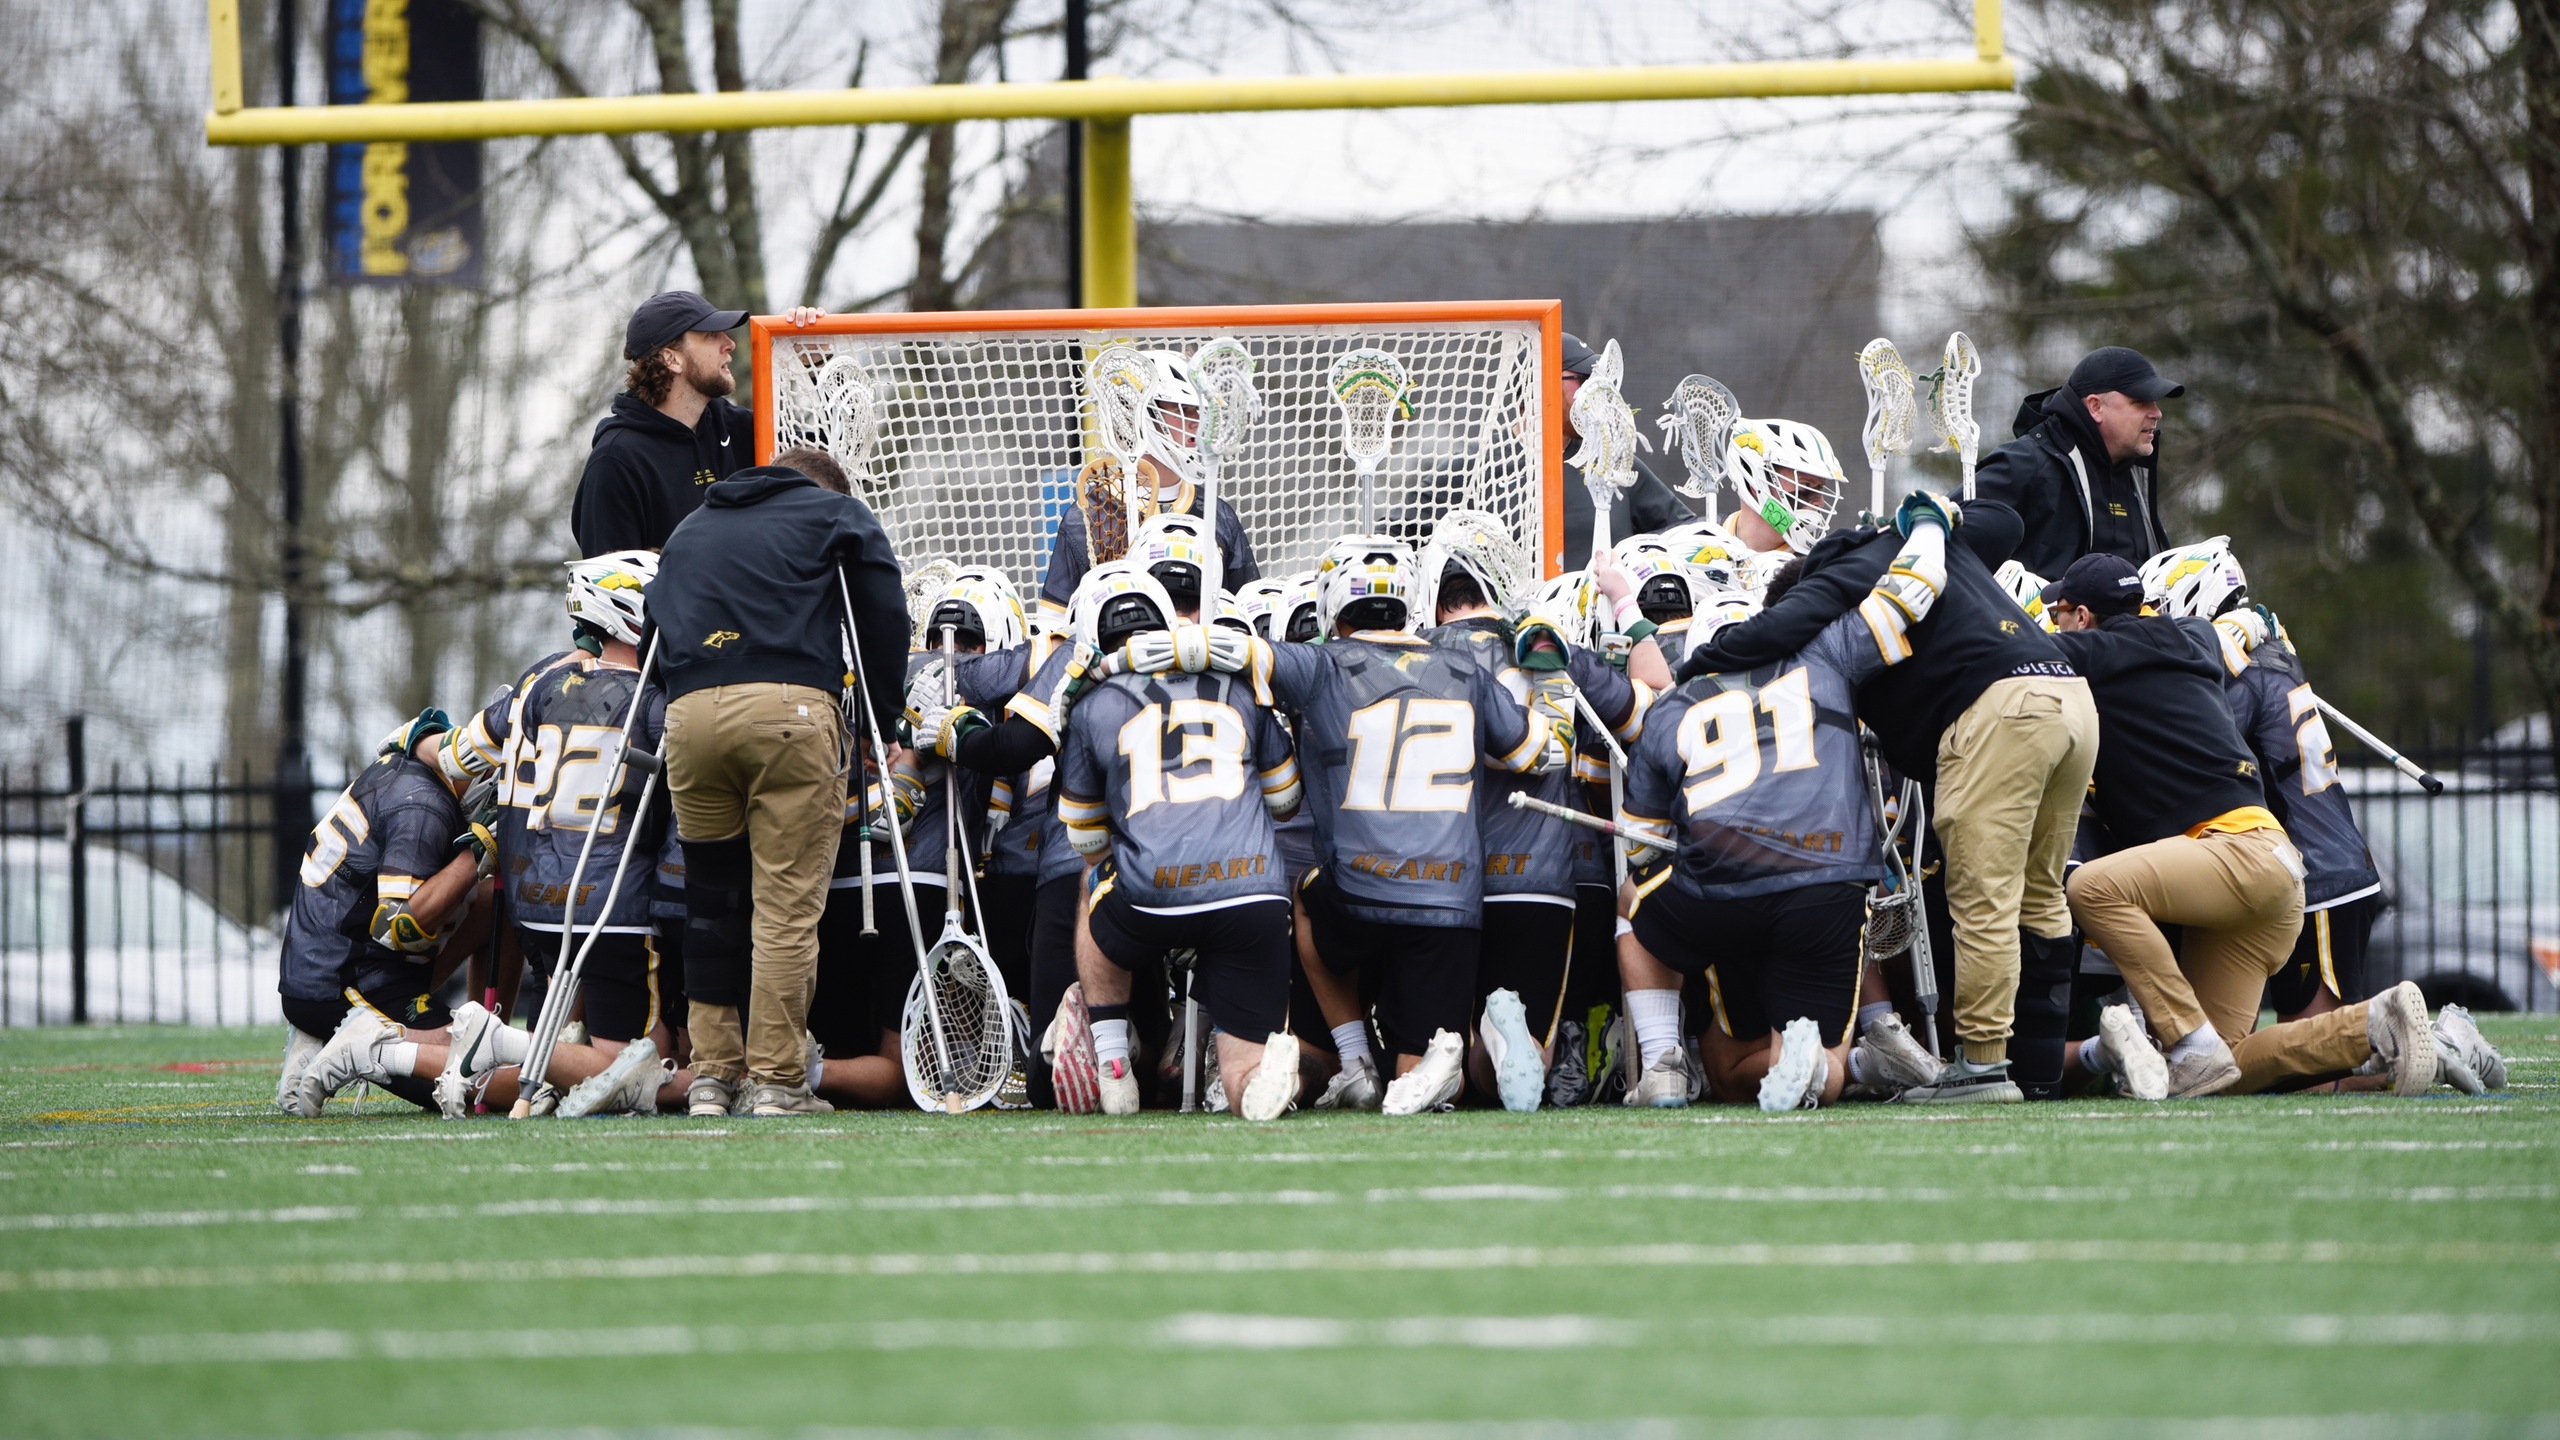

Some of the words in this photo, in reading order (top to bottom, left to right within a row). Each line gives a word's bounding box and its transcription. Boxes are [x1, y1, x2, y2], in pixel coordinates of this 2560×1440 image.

[527, 724, 632, 834] 22
[1118, 699, 1246, 819] 13
[1340, 699, 1475, 813] 12
[1677, 666, 1819, 817] 91
[1154, 854, 1267, 889] HEART
[1351, 853, 1467, 883] HEART
